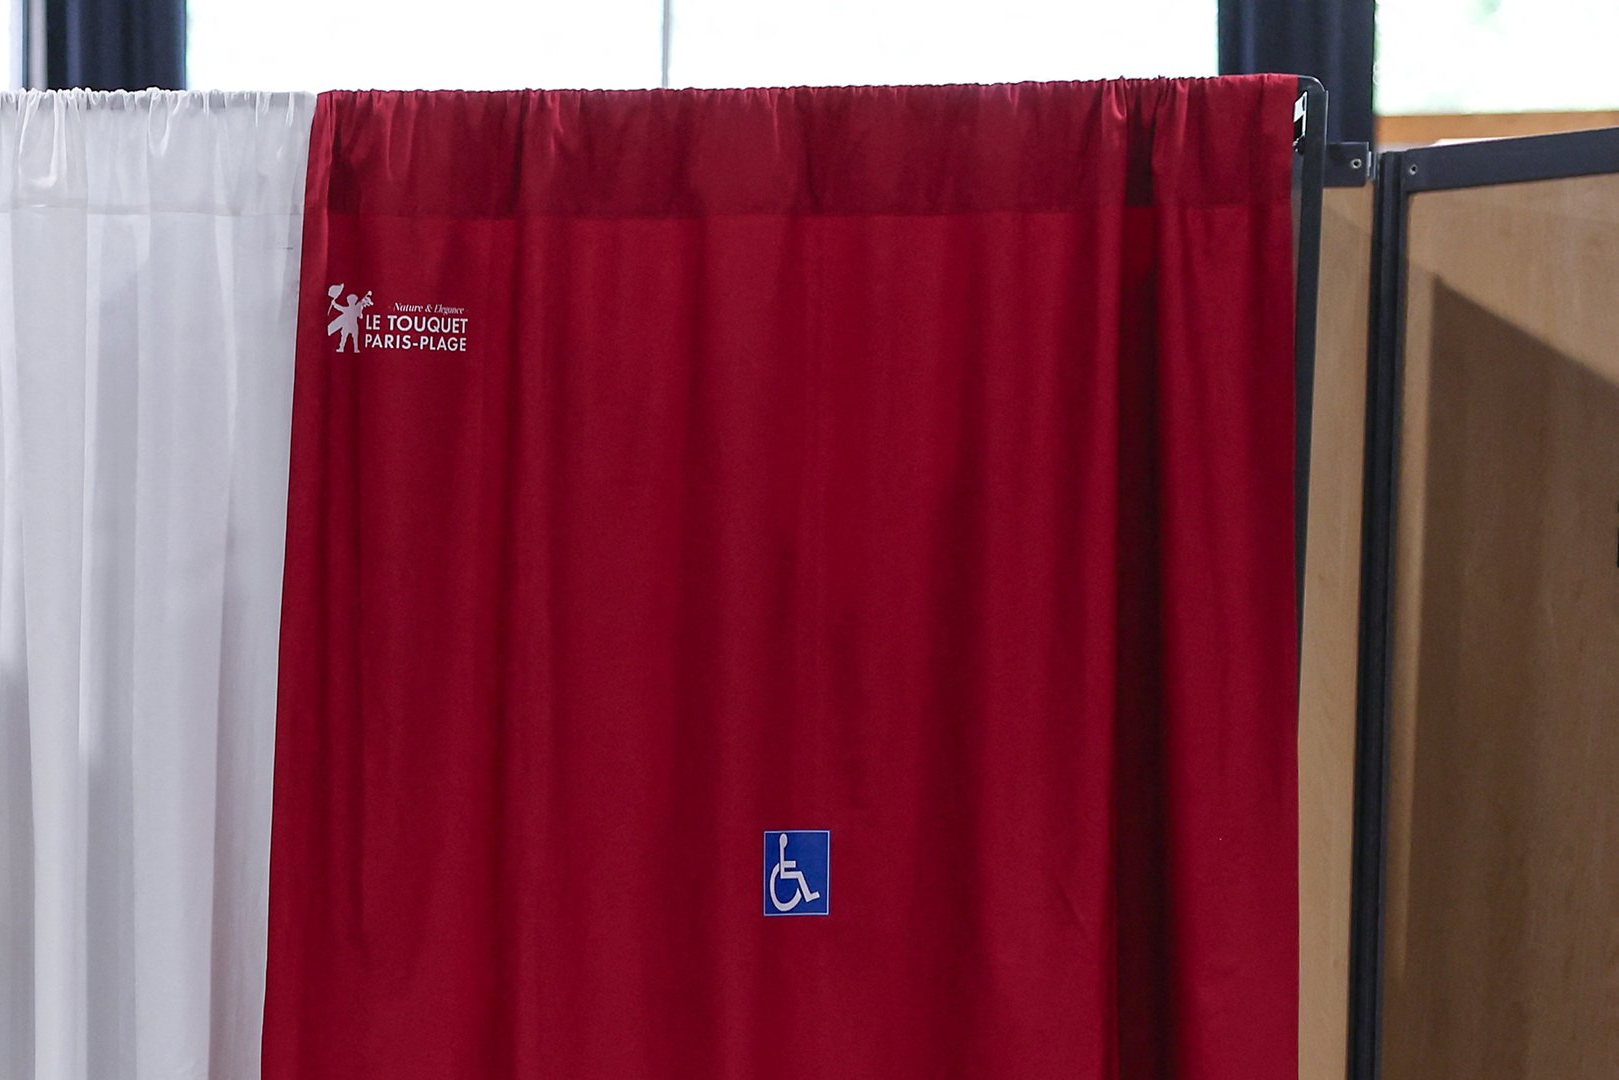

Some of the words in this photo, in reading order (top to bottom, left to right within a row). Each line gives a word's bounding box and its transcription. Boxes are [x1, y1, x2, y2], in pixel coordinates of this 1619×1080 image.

[393, 302, 423, 313] Nature
[425, 304, 432, 313] &
[434, 304, 465, 315] Elegance
[365, 314, 381, 331] LE
[387, 315, 469, 334] TOUQUET
[364, 334, 467, 352] PARIS-PLAGE
